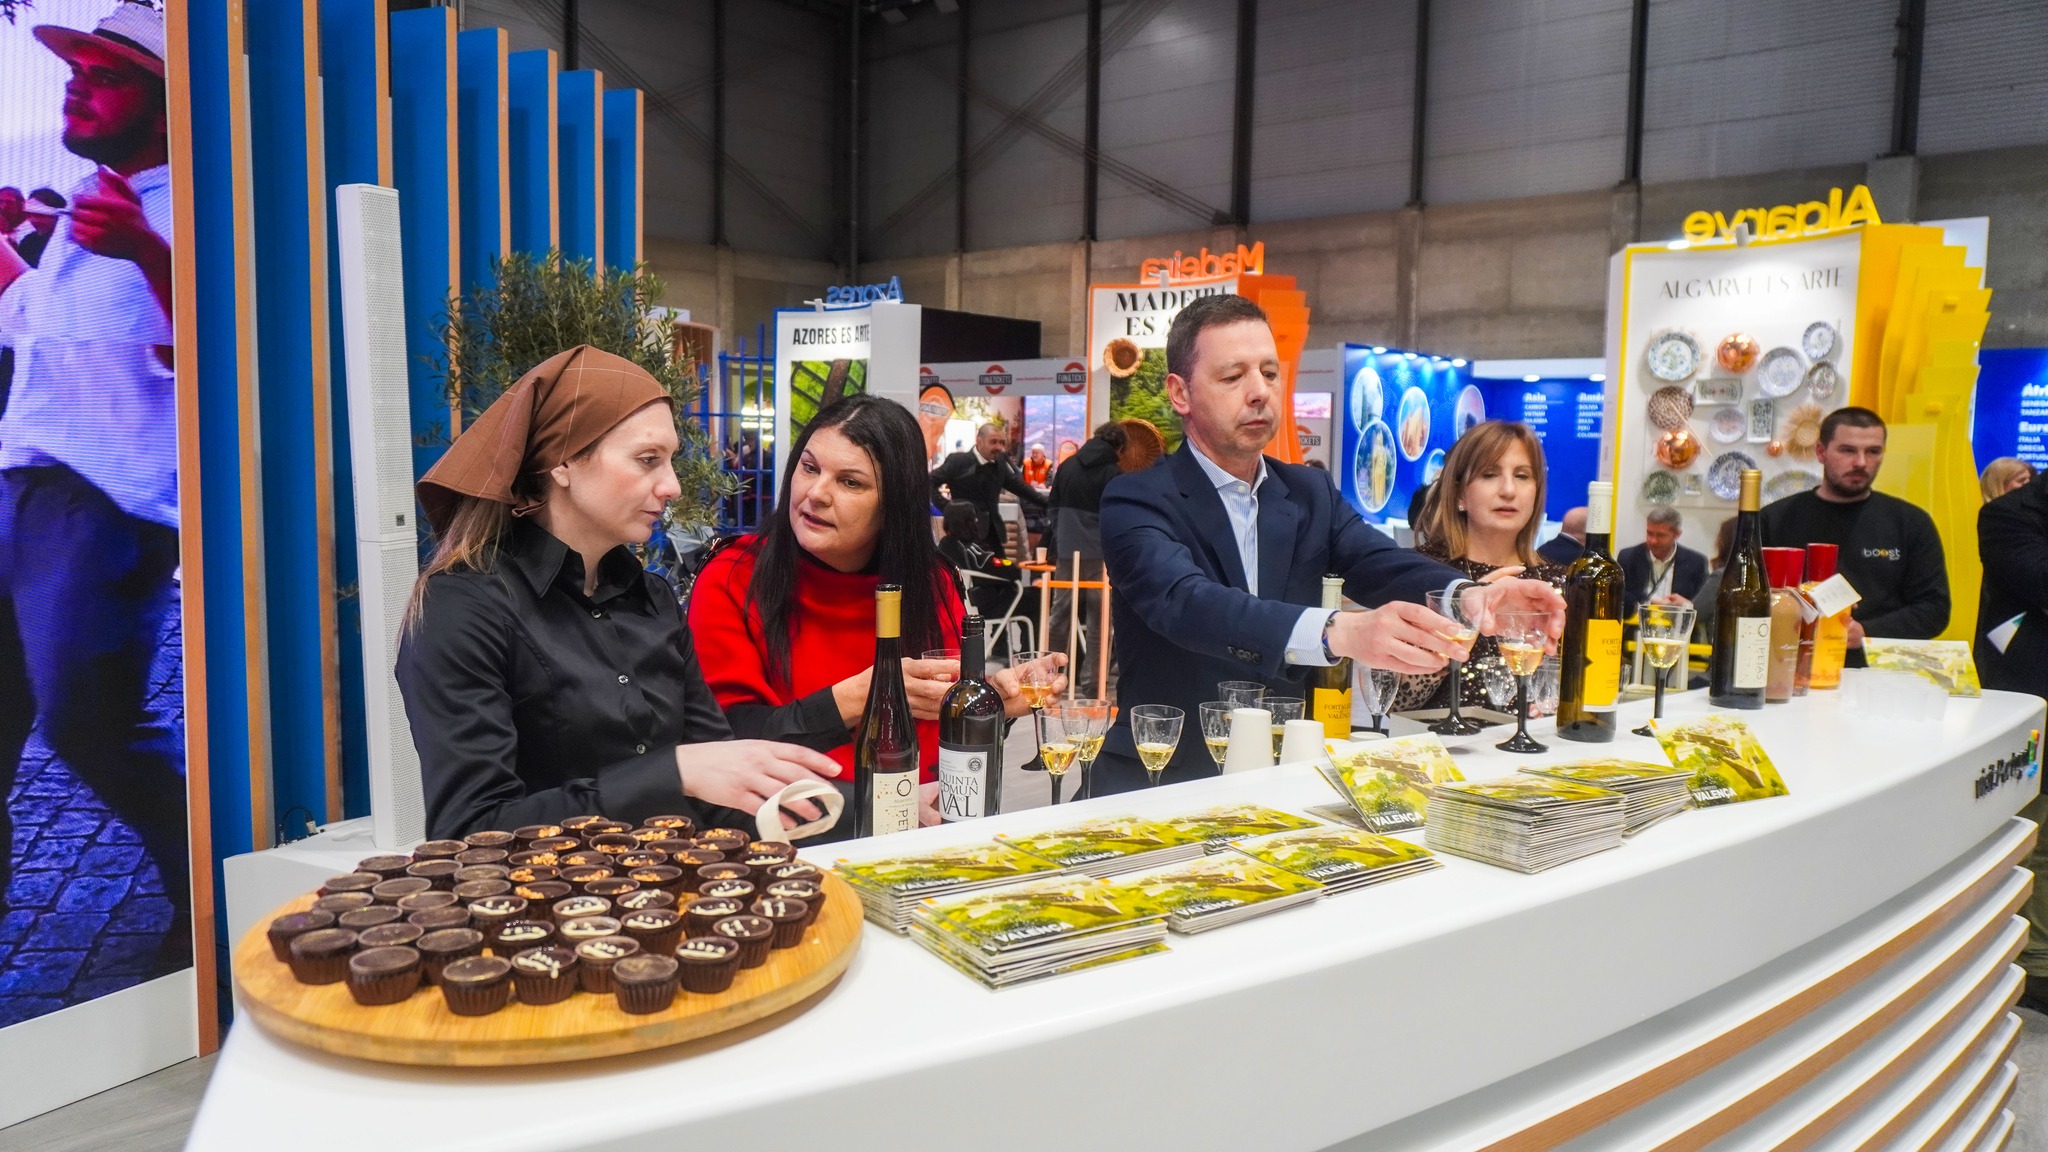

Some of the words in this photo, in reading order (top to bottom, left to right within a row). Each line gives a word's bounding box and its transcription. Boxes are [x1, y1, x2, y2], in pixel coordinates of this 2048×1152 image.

[1800, 267, 1845, 290] ARTE
[793, 327, 837, 345] AZORES
[841, 326, 852, 344] ES
[855, 324, 870, 343] ARTE
[1126, 317, 1154, 335] ES
[940, 770, 978, 786] QUINTA
[1693, 787, 1737, 801] VALENÇA
[941, 790, 977, 817] VAL
[1371, 811, 1424, 826] VALENÇA
[1176, 899, 1245, 915] VALENÇA
[994, 922, 1075, 942] VALENÇA
